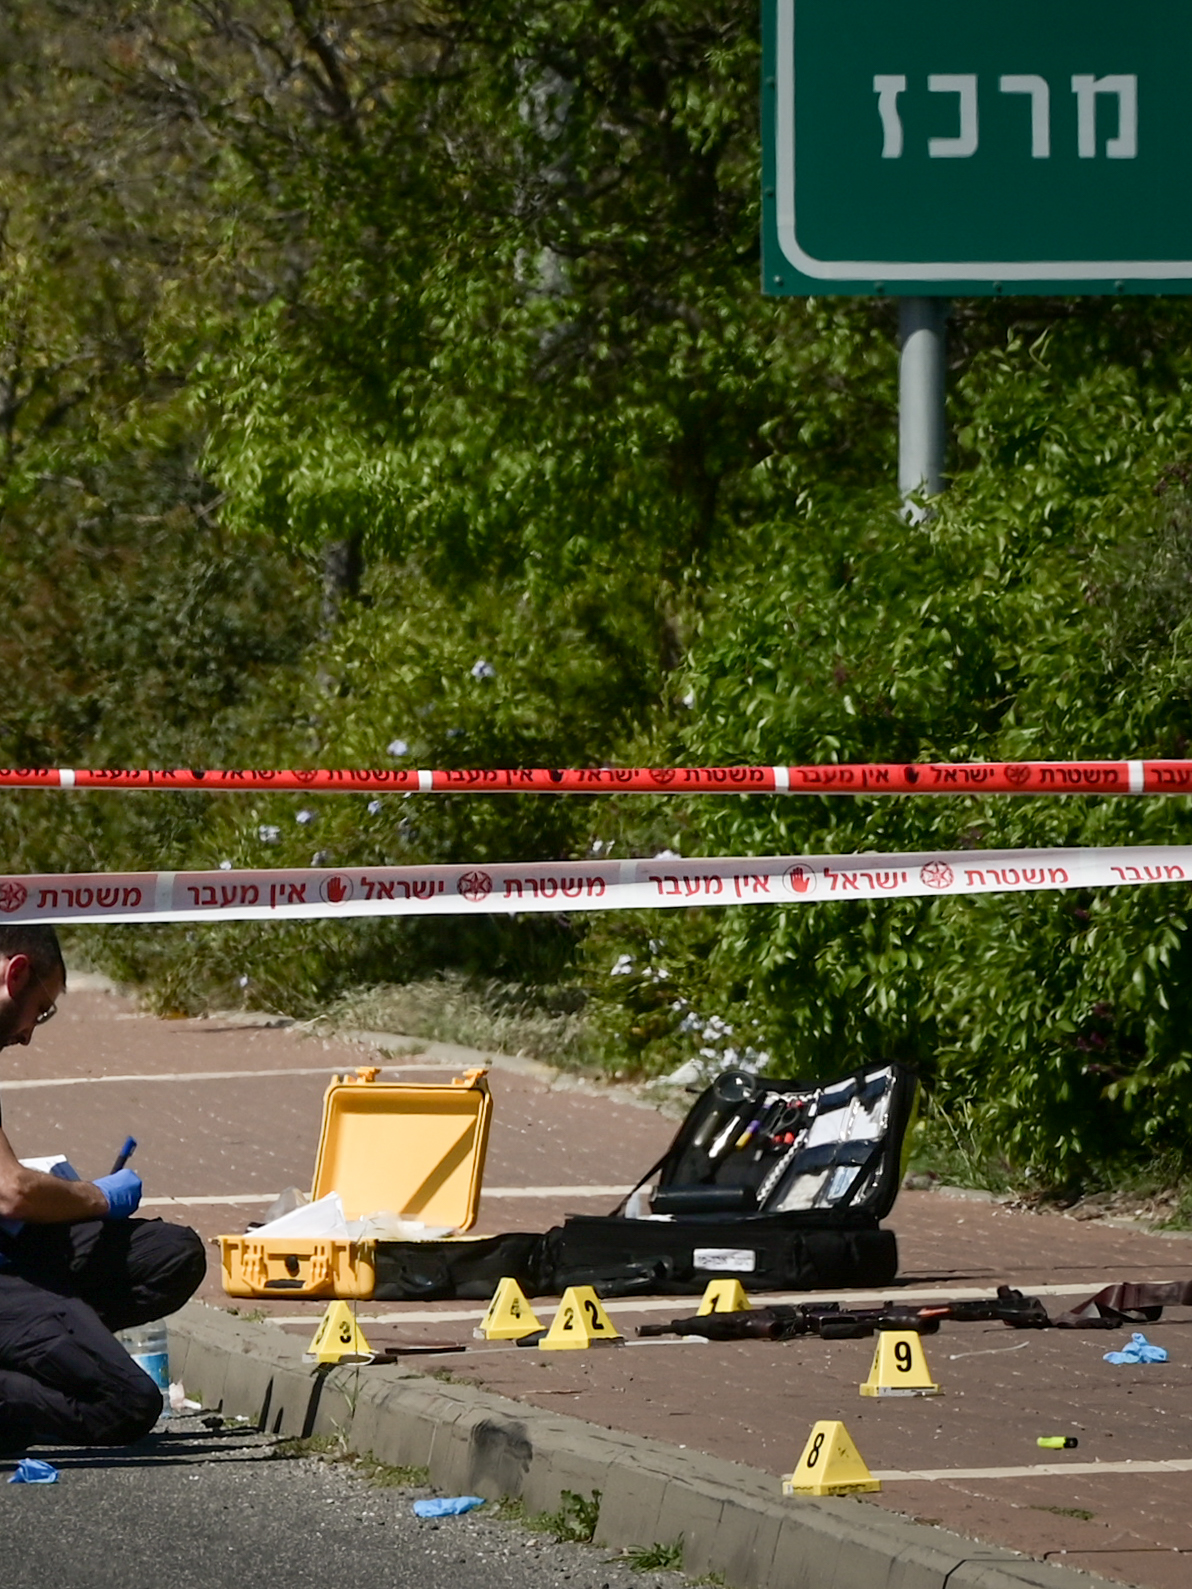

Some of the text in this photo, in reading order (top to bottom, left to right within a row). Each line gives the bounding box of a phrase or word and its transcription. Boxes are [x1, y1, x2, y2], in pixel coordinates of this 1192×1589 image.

[873, 73, 1138, 159] מרכז
[683, 768, 765, 782] משטרת
[796, 768, 855, 783] מעבר
[861, 767, 890, 787] אין
[930, 765, 995, 784] ישראל
[1038, 767, 1119, 784] משטרת
[1151, 767, 1192, 784] עבר
[823, 866, 908, 891] ישראל
[963, 866, 1070, 887] משטרת
[1110, 863, 1185, 882] מעבר
[187, 882, 260, 907] מעבר
[269, 880, 307, 909] אין
[360, 876, 445, 901] ישראל
[502, 874, 606, 899] משטרת
[648, 873, 724, 897] מעבר
[732, 873, 771, 898] אין
[36, 886, 142, 910] משטרת
[563, 1308, 574, 1330] 2
[584, 1300, 604, 1330] 2
[339, 1320, 352, 1344] 3
[894, 1341, 912, 1373] 9
[807, 1432, 825, 1468] 8
